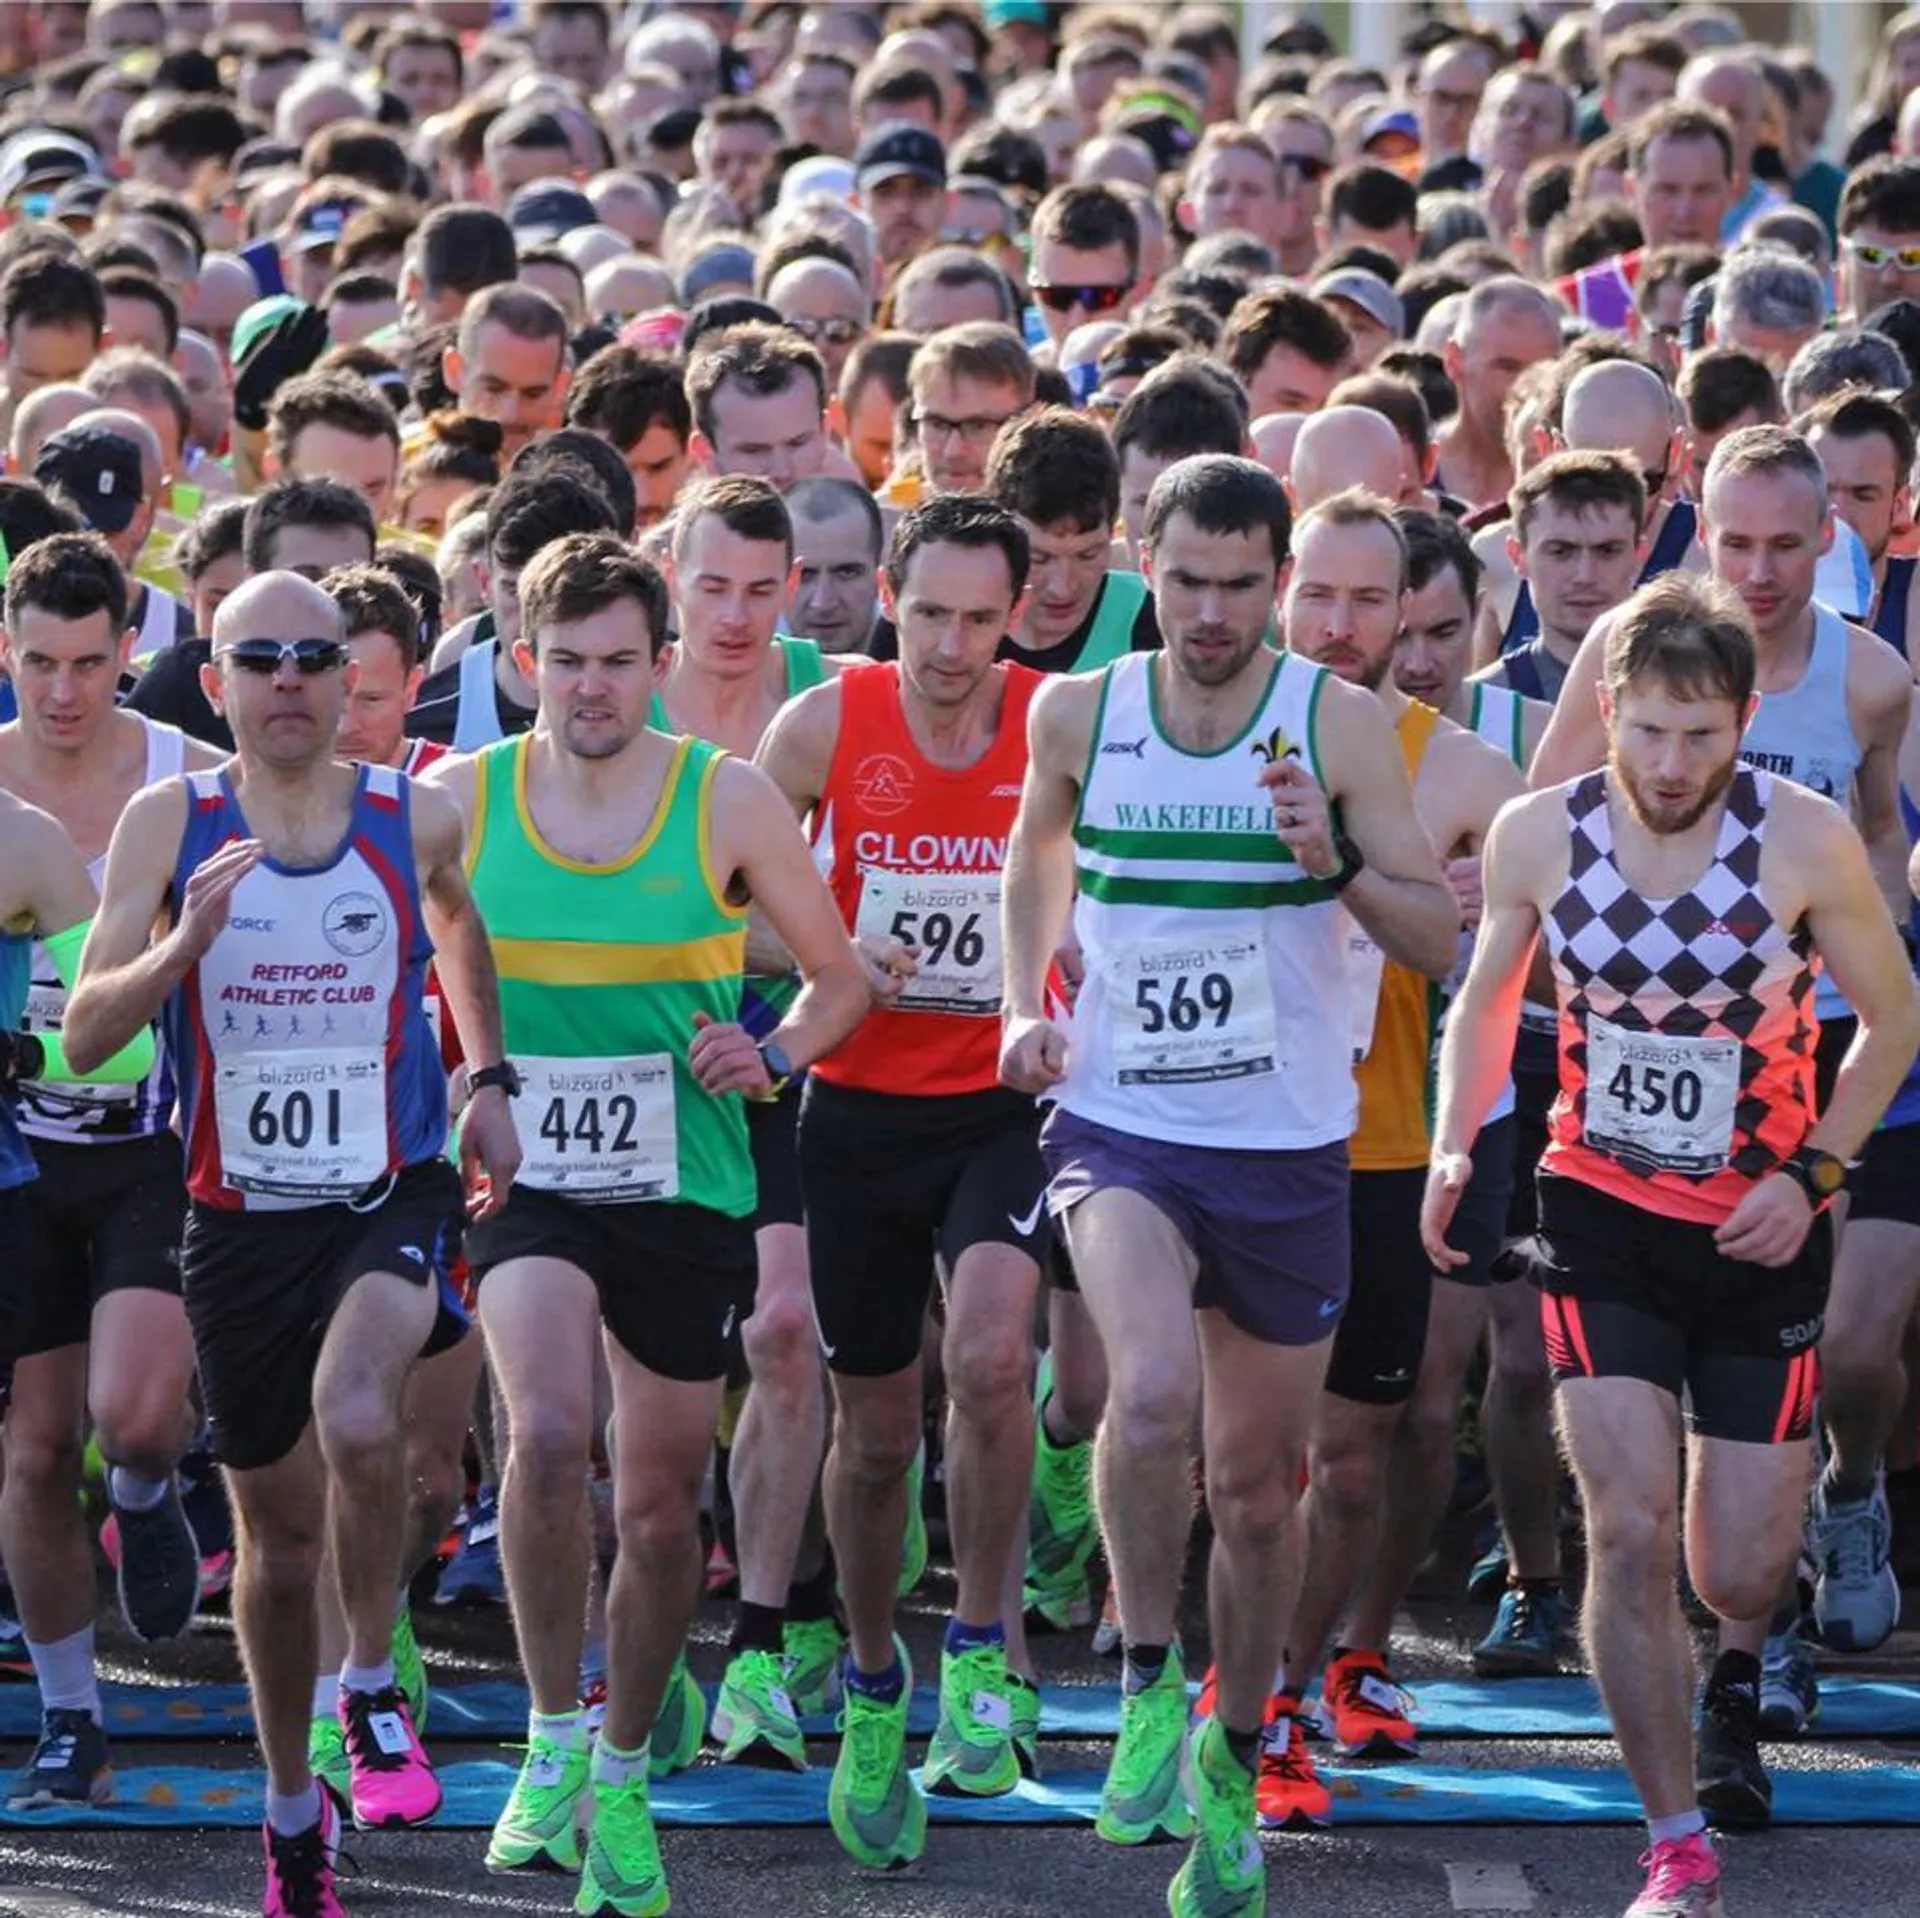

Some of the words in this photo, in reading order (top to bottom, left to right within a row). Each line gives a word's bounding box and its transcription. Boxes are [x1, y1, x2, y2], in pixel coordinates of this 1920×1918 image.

[890, 911, 985, 967] 596
[221, 985, 317, 1006] ATHLETIC
[322, 985, 376, 1004] CLUB
[251, 963, 348, 982] RETFORD
[1136, 973, 1233, 1034] 569
[249, 1089, 341, 1148] 601
[1608, 1063, 1703, 1122] 450
[540, 1094, 639, 1153] 442
